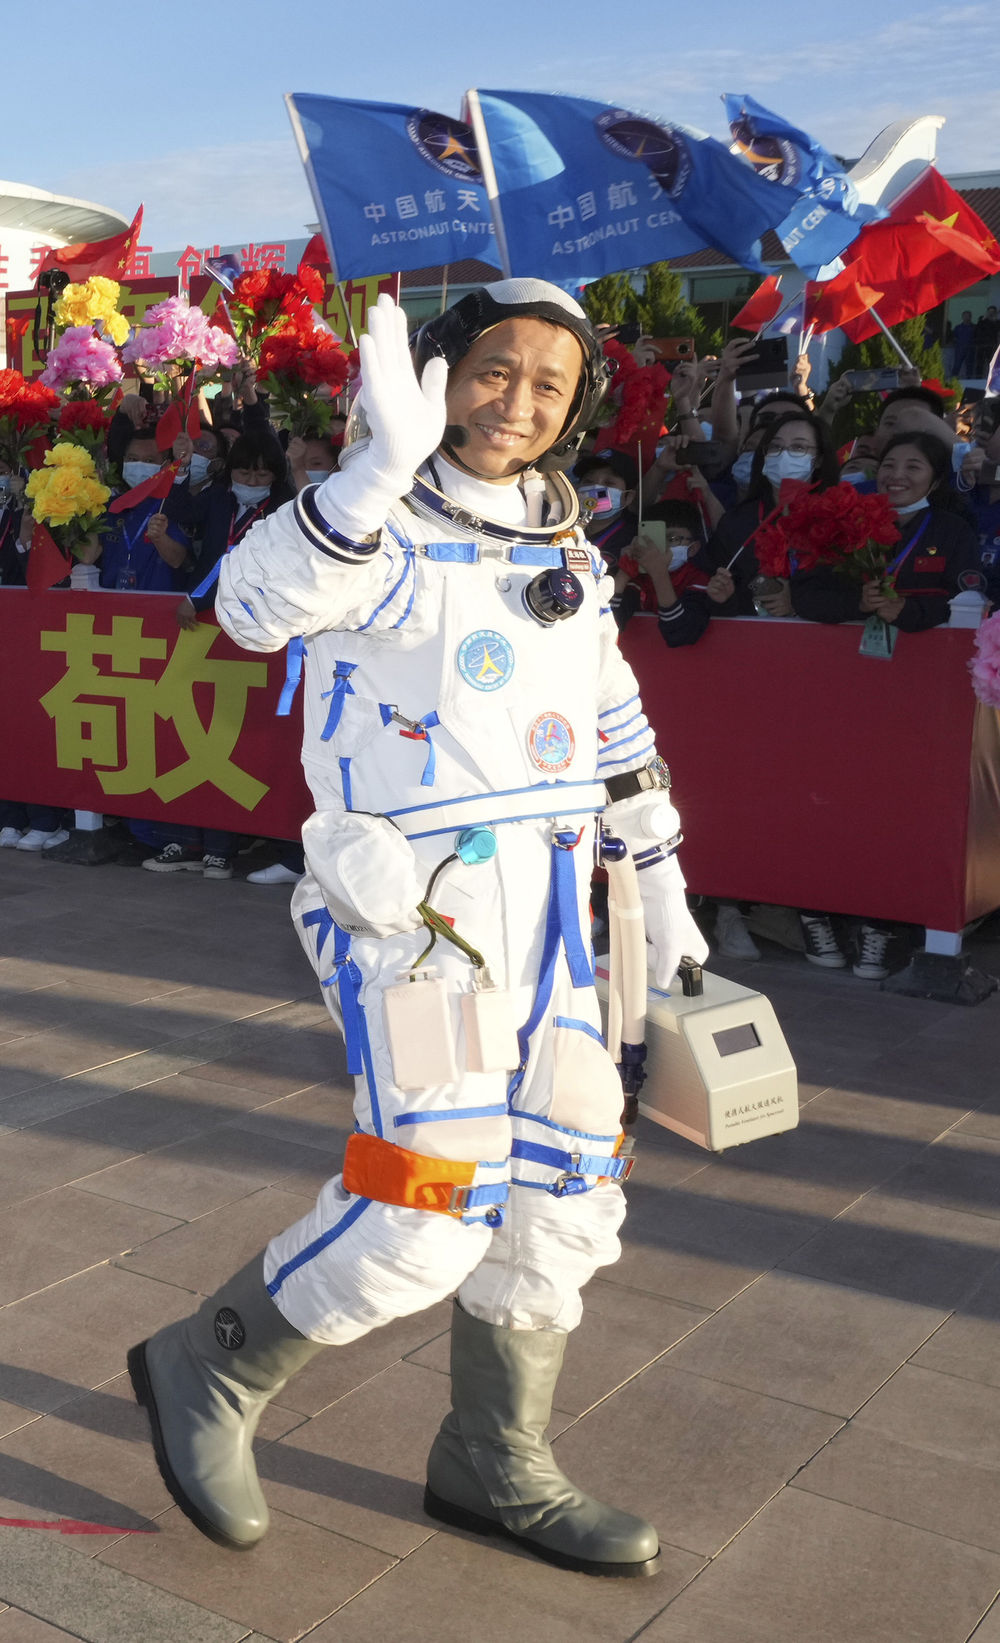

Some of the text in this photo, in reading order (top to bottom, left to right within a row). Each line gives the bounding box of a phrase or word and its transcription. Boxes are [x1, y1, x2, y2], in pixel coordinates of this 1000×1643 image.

[363, 189, 481, 223] 中国航天
[371, 221, 450, 247] ASTRONAUT
[552, 218, 640, 256] ASTRONAUT
[38, 612, 271, 812] 敬
